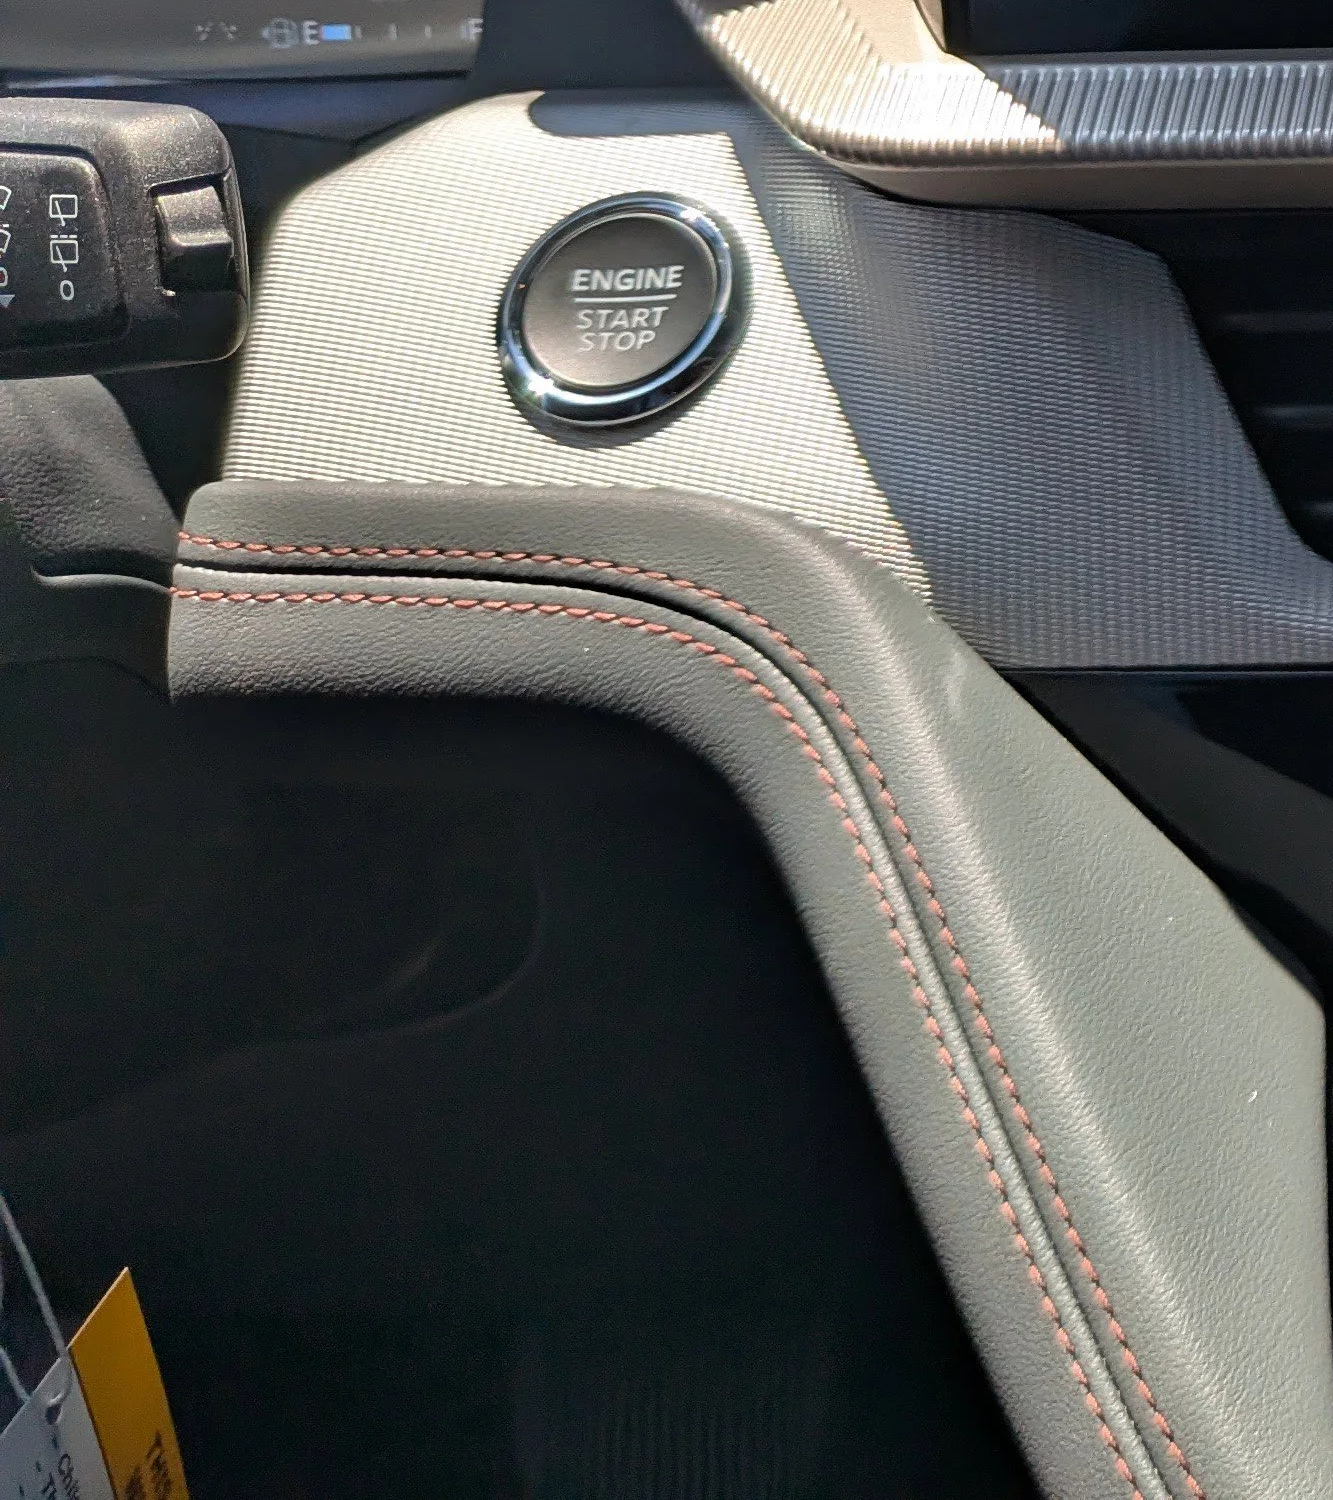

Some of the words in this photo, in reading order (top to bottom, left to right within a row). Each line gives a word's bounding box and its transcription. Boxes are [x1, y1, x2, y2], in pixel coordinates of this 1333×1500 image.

[571, 265, 685, 292] ENGINE
[576, 306, 670, 330] START
[577, 329, 657, 352] STOP
